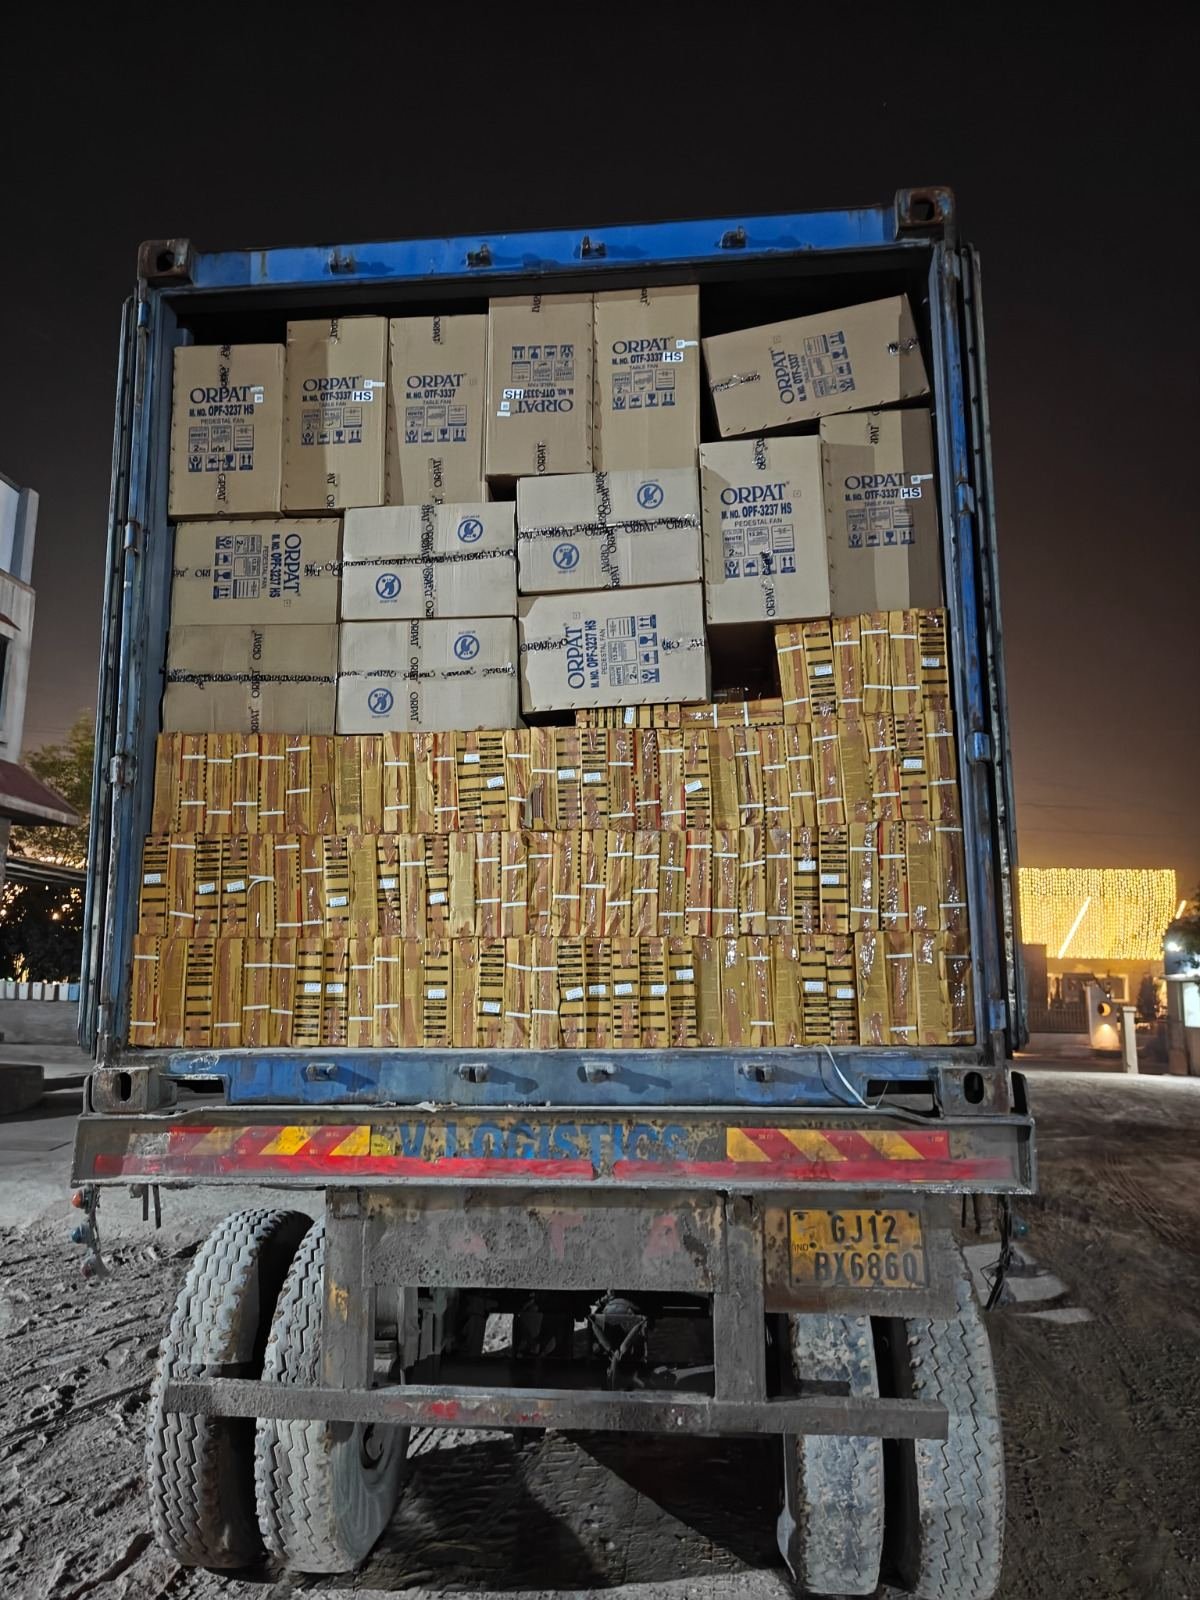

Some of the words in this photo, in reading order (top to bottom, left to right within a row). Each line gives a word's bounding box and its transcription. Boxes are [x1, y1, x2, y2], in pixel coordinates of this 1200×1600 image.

[612, 337, 670, 354] ORPAT
[630, 353, 663, 364] OTF-3337
[664, 352, 682, 361] HS
[303, 376, 360, 391] ORPAT
[407, 374, 464, 389] ORPAT
[771, 350, 795, 404] ORPAT
[190, 386, 250, 404] ORPAT
[353, 391, 372, 401] HS
[424, 389, 456, 399] OTF-3337
[504, 390, 522, 399] HS
[208, 404, 242, 417] OPF-3237
[243, 404, 254, 415] HS
[516, 399, 574, 413] ORPAT
[845, 472, 909, 490] ORPAT
[720, 483, 786, 505] ORPAT
[902, 488, 920, 498] HS
[730, 509, 740, 519] NO.
[742, 503, 779, 518] OPF-3237
[780, 502, 792, 515] HS
[734, 519, 767, 527] PEDESTAL
[269, 552, 282, 586] OPF-3237
[283, 533, 302, 594] ORPAT
[269, 587, 280, 598] HS
[584, 620, 597, 631] HS
[565, 626, 585, 690] ORPAT
[585, 632, 598, 668] OPF-3237
[831, 1214, 899, 1244] GJ12
[814, 1251, 918, 1282] BX6860
